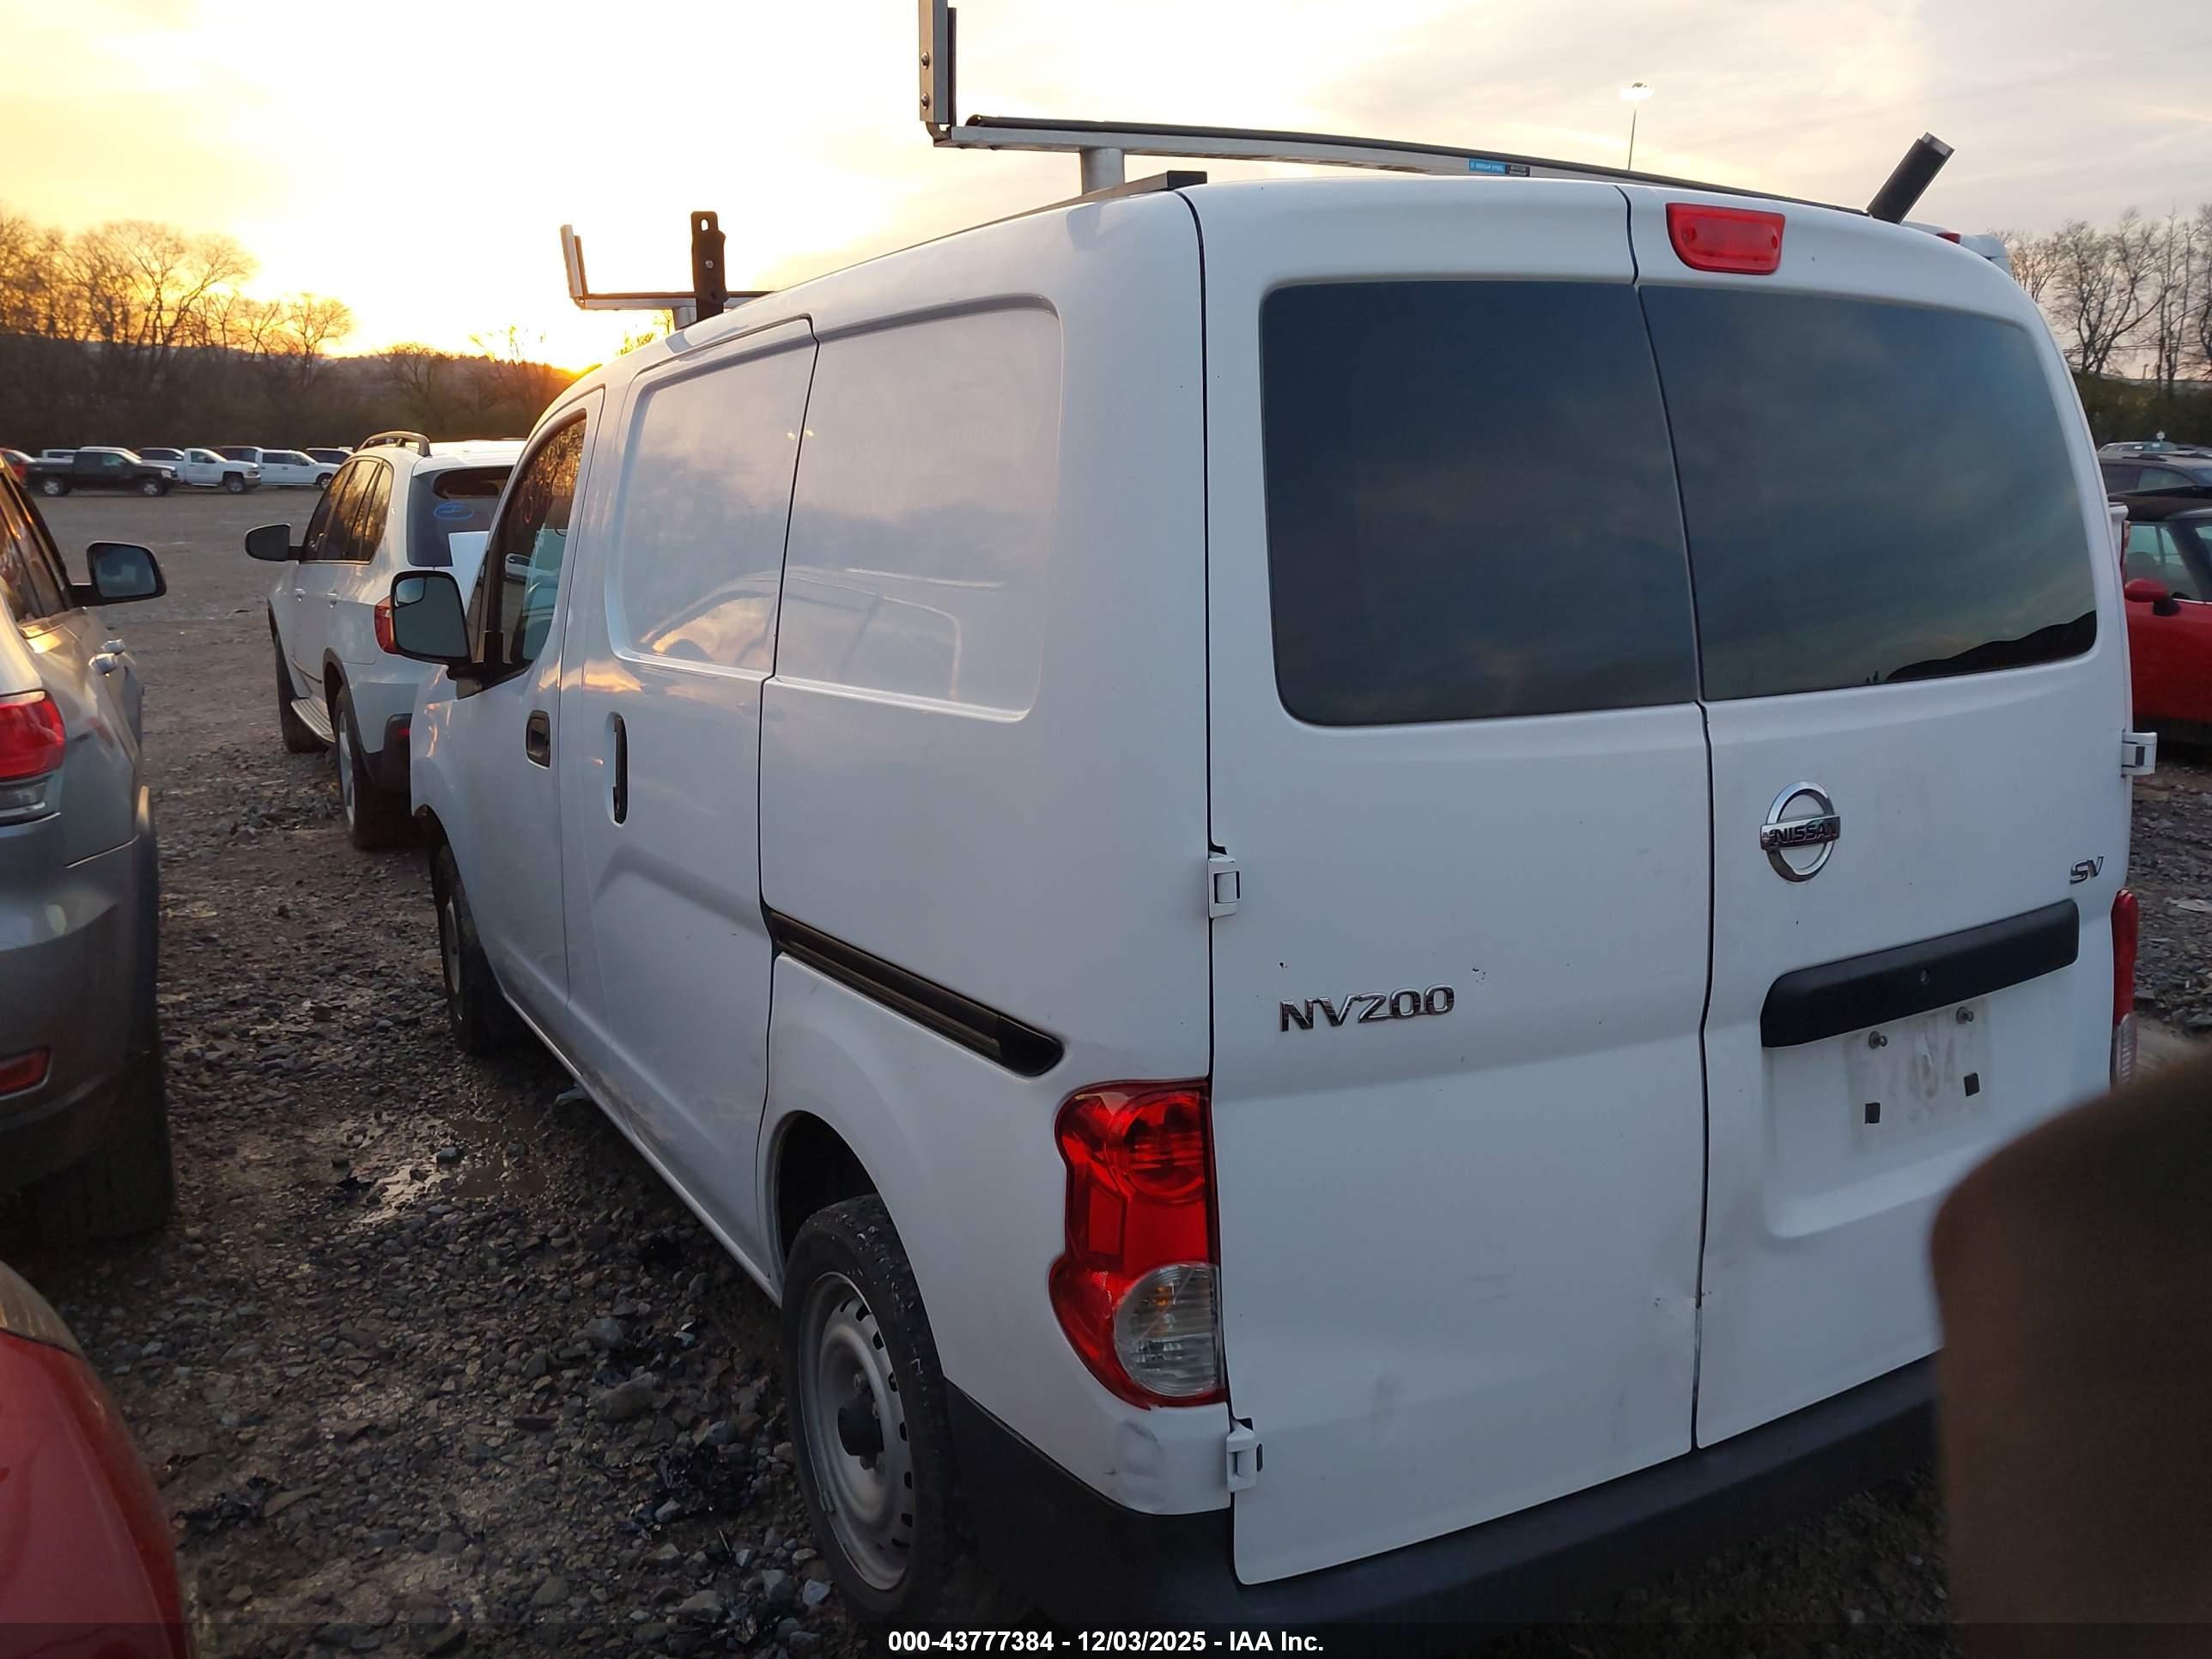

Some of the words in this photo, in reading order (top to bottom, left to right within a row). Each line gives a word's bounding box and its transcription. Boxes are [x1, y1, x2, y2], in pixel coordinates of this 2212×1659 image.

[1774, 822, 1837, 846] NISSAN
[2069, 855, 2104, 885] SV
[1279, 984, 1455, 1032] NV200
